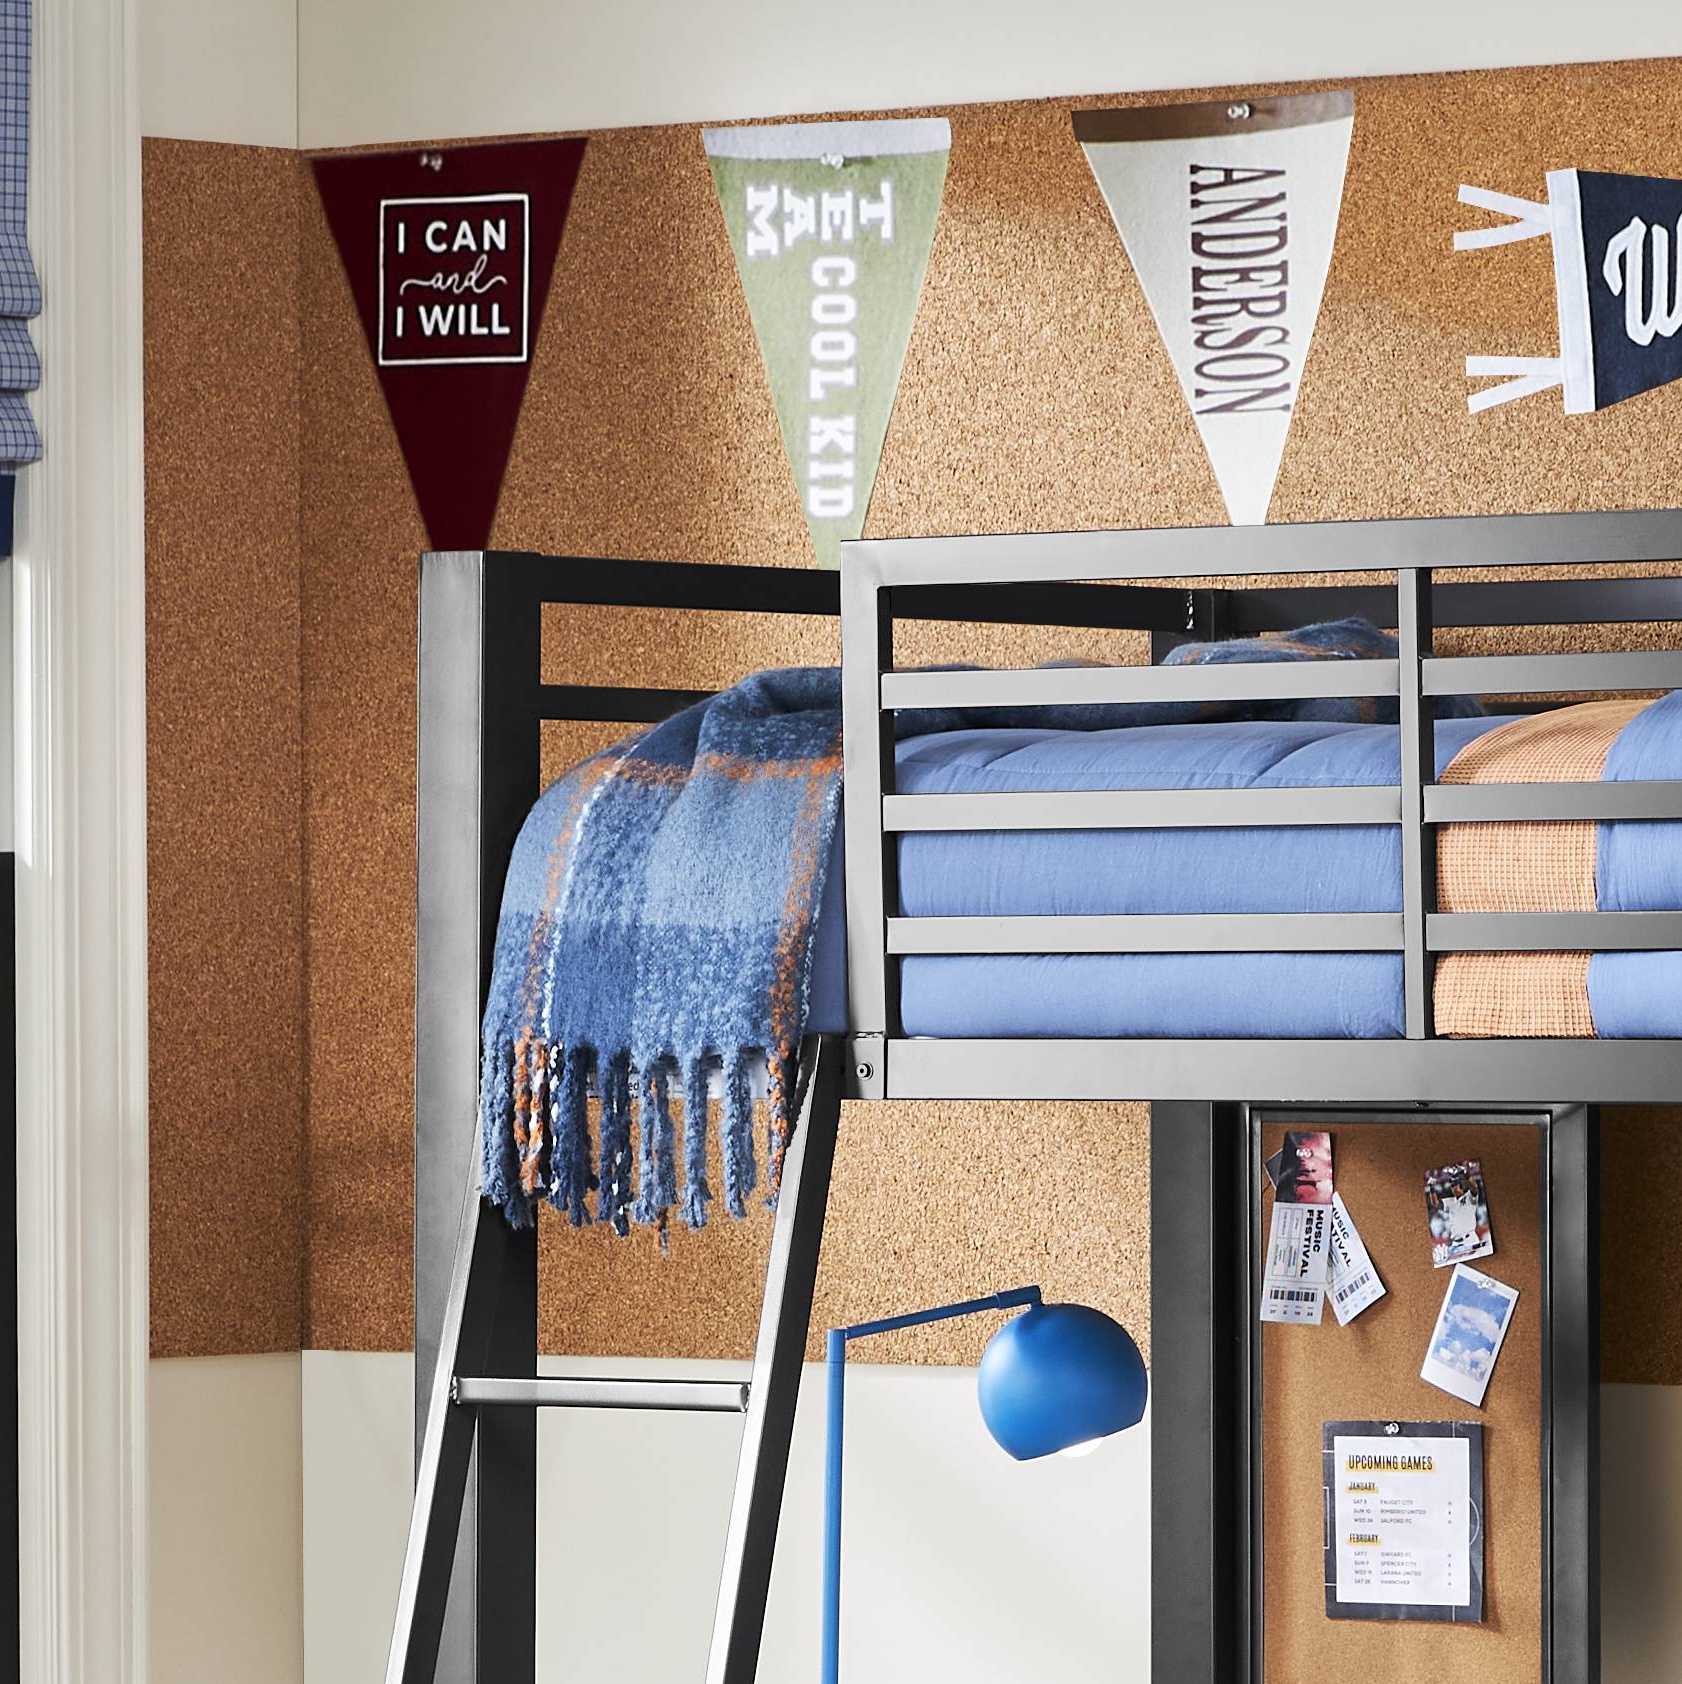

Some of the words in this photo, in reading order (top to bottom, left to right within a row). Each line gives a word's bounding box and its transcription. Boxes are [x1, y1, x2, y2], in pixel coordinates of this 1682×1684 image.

[398, 222, 405, 253] I
[425, 219, 506, 253] CAN
[746, 181, 893, 257] TEAM
[400, 253, 507, 295] and
[1189, 163, 1291, 415] ANDERSON
[396, 306, 403, 337] I
[419, 303, 510, 336] WILL
[810, 256, 857, 400] COOL
[808, 416, 855, 517] KID
[1300, 1209, 1315, 1278] FESTIVAL
[1312, 1209, 1324, 1253] MUSIC
[1331, 1223, 1351, 1267] TIVAL
[1348, 1454, 1398, 1470] UPCOMING
[1400, 1455, 1433, 1470] GAMES
[1348, 1481, 1376, 1491] JANUARY
[1349, 1533, 1378, 1543] FEBRUARY
